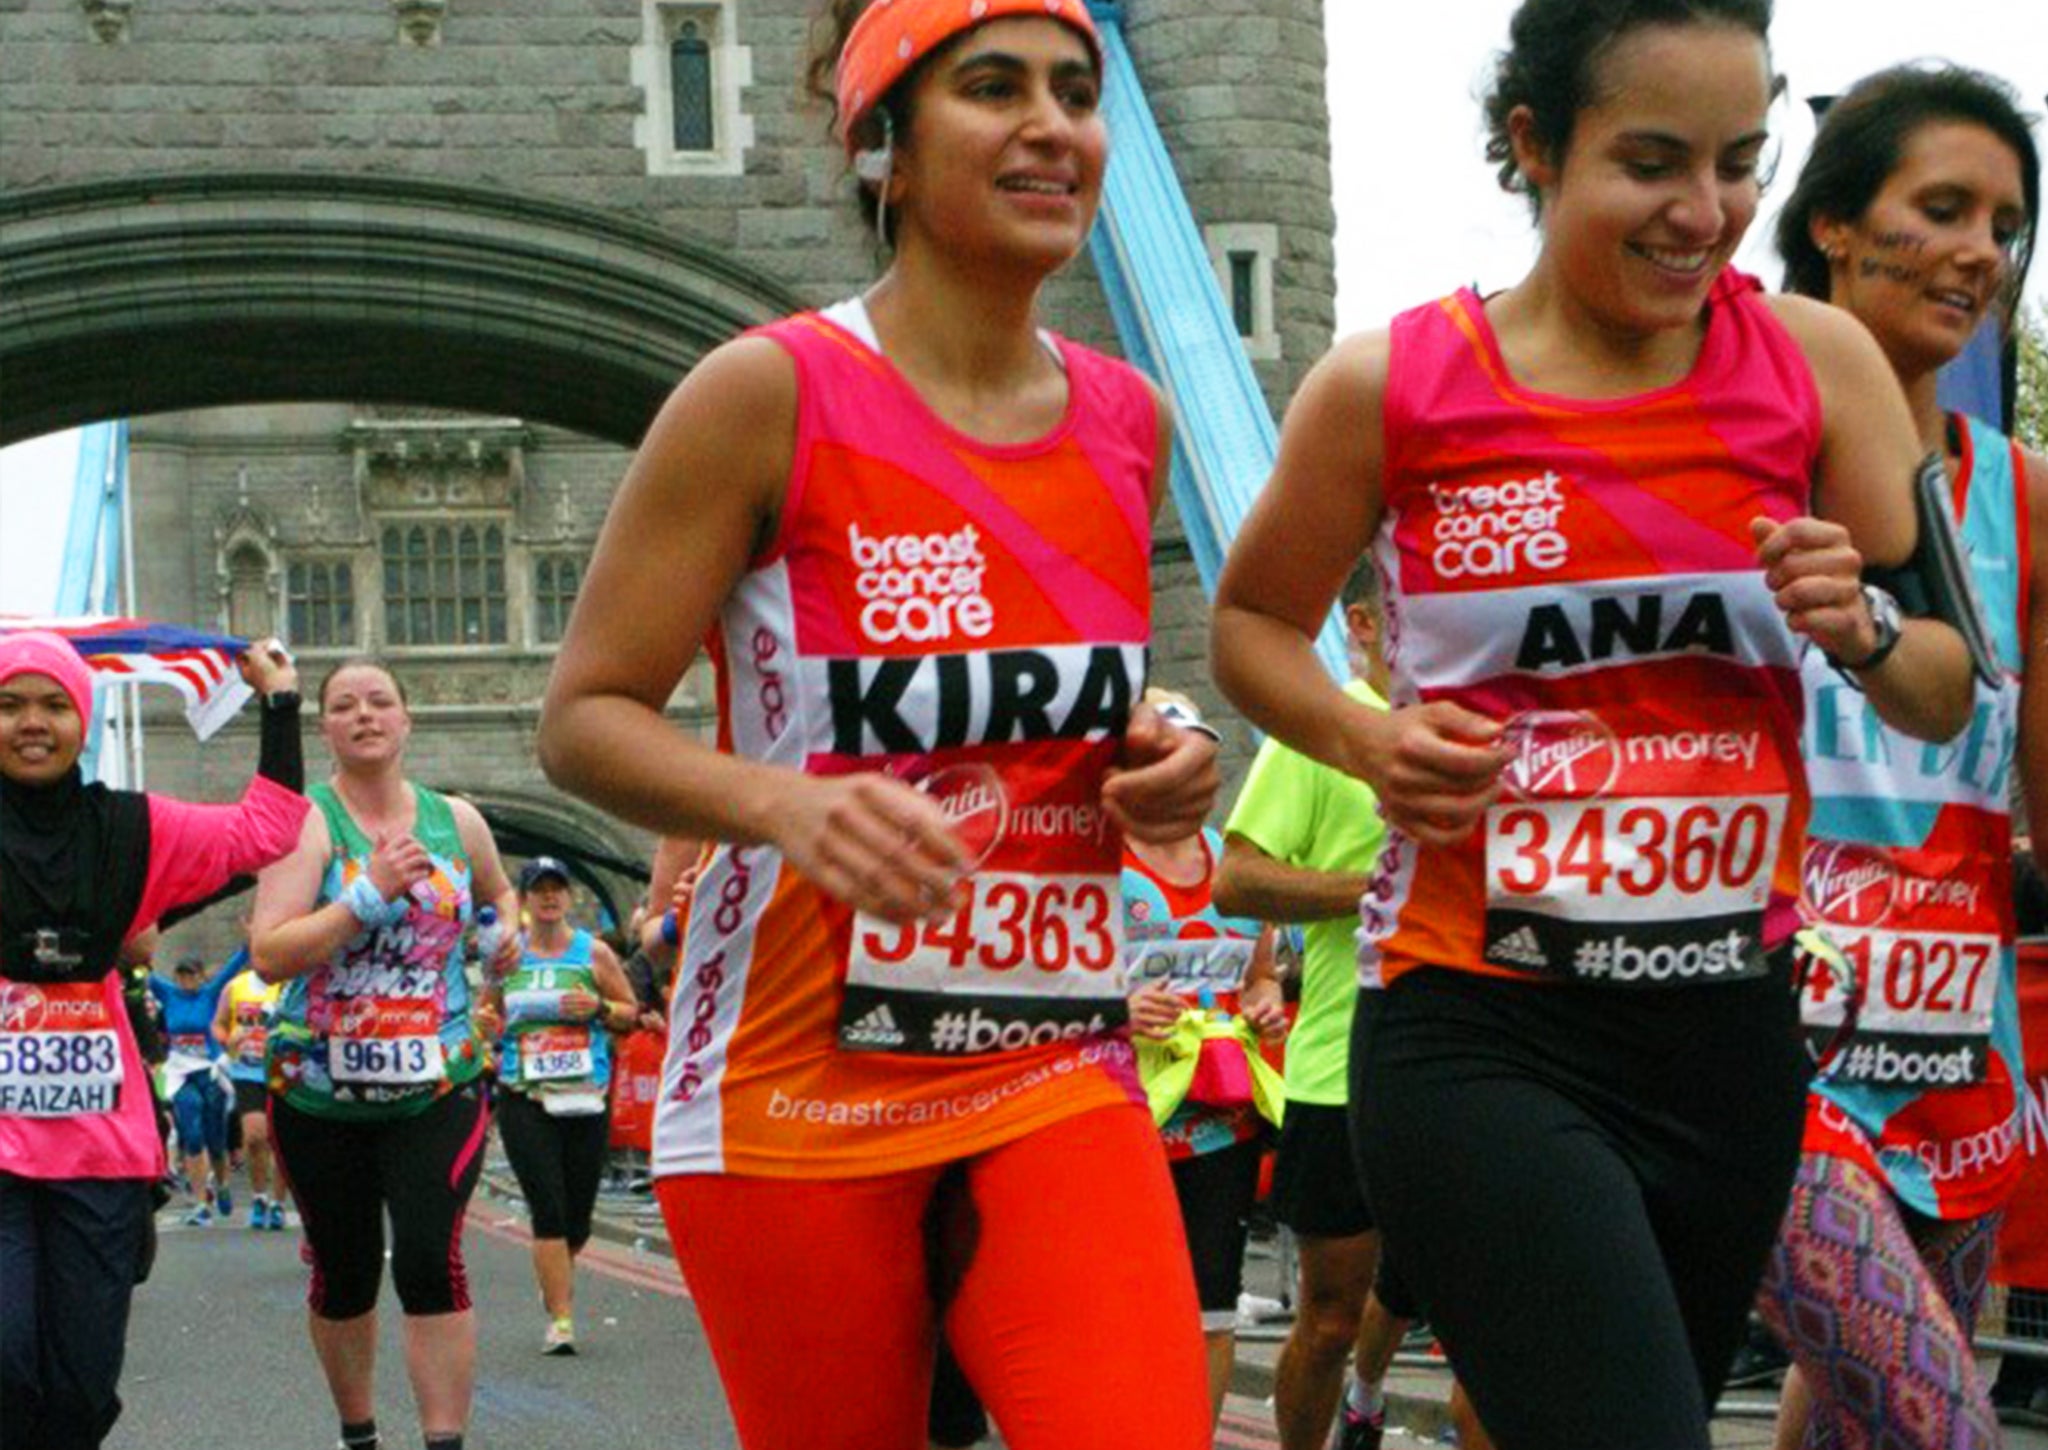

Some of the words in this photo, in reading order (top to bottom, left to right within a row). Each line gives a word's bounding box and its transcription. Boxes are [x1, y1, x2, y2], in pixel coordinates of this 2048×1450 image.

[1427, 470, 1565, 516] breast
[848, 522, 985, 570] breast
[1433, 504, 1566, 542] cancer
[1432, 530, 1570, 580] care
[855, 562, 987, 600] cancer
[860, 593, 994, 643] care
[1514, 592, 1737, 670] ANA
[1497, 803, 1771, 897] 34360
[1804, 845, 1894, 922] Virgin
[1573, 929, 1749, 981] #boost
[0, 1034, 115, 1076] 58383
[342, 1038, 427, 1074] 9613
[1847, 1042, 1975, 1084] #boost
[1, 1084, 106, 1113] FAIZAH
